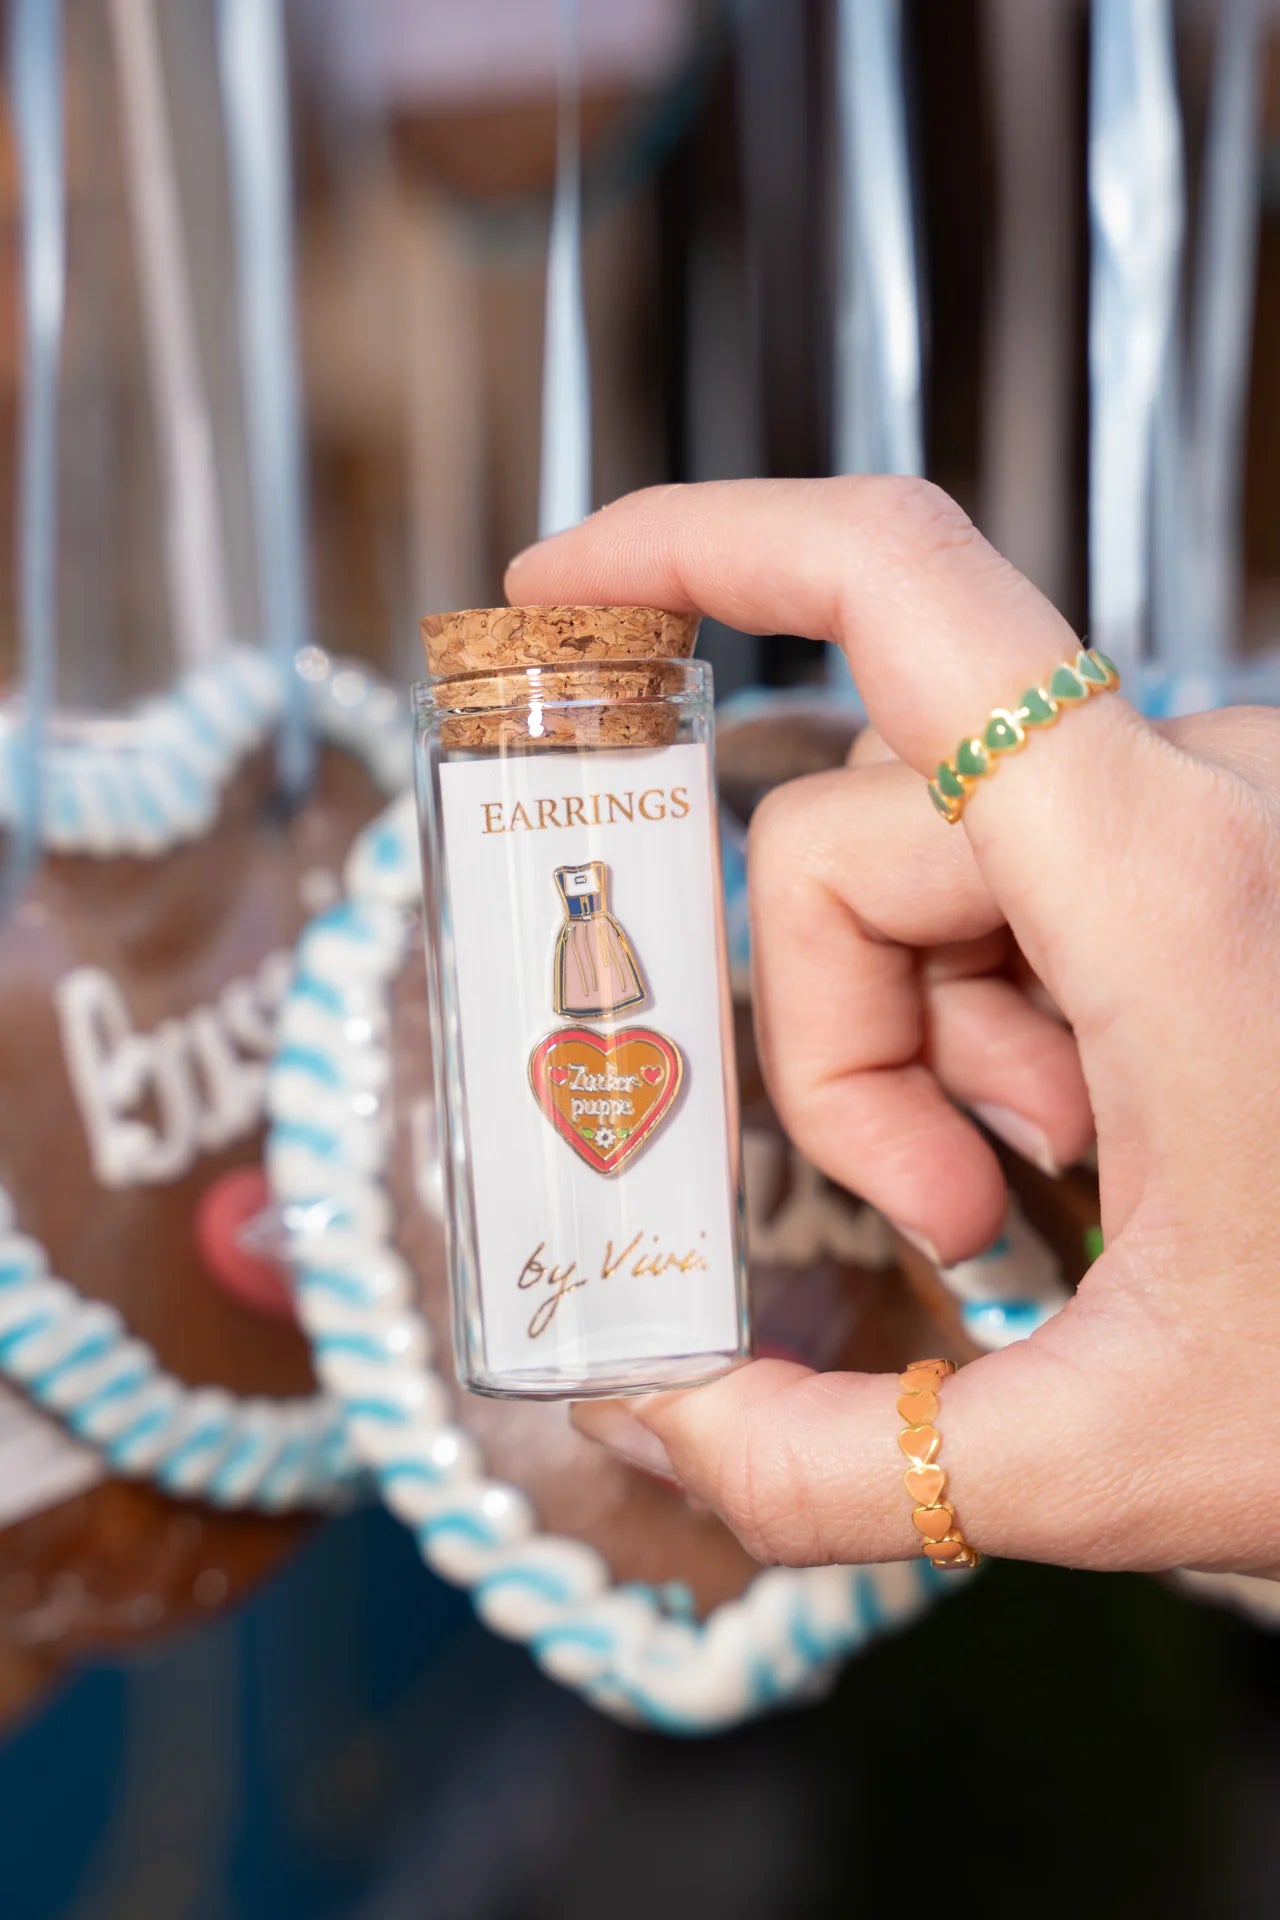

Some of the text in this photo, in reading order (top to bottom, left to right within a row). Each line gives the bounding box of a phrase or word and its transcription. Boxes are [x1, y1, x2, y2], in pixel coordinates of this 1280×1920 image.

[480, 787, 691, 834] EARRINGS
[571, 1098, 634, 1125] puppe
[517, 1241, 588, 1339] by
